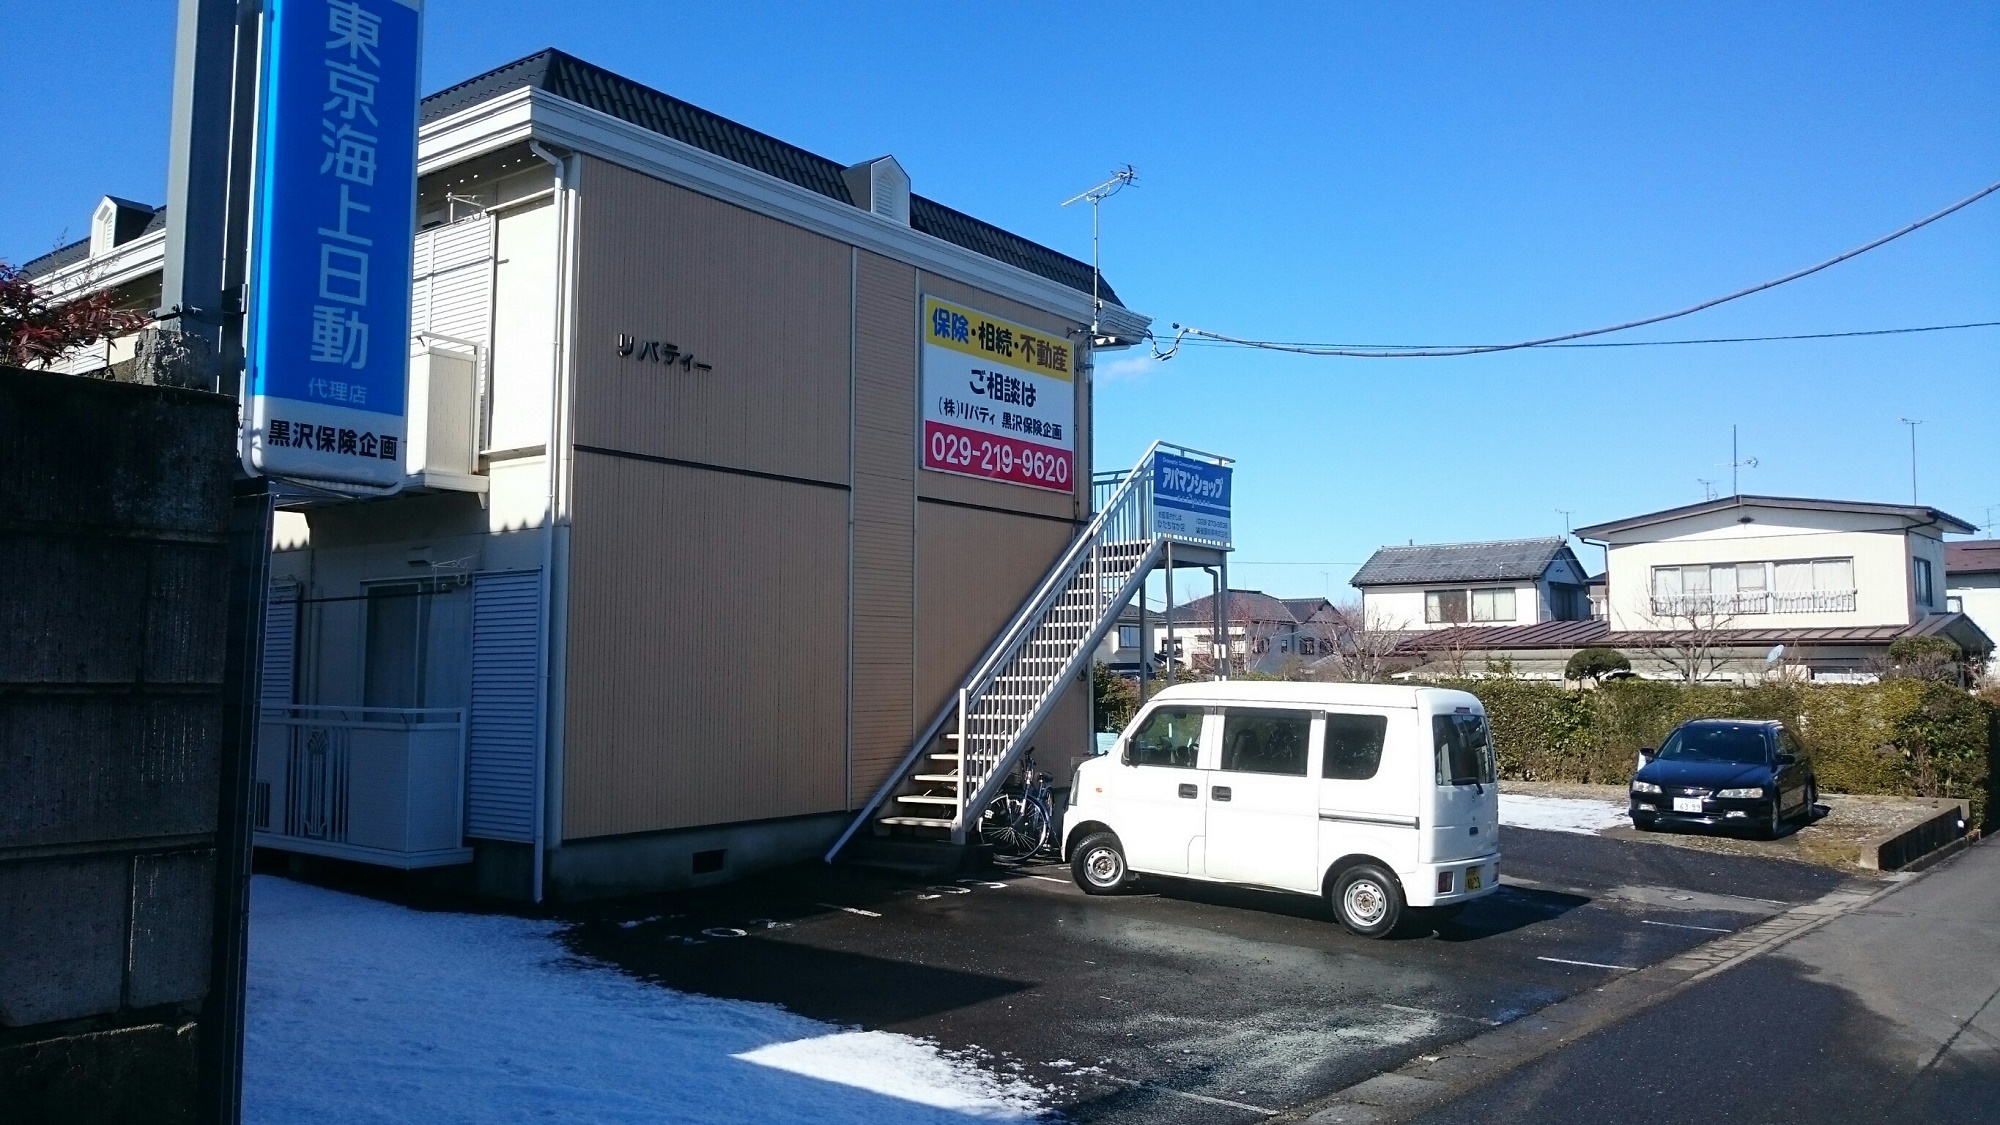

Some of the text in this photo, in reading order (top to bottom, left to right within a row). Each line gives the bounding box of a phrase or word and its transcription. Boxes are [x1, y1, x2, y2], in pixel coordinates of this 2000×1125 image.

[310, 0, 382, 370] 東京海上日動
[618, 333, 712, 372] リバティー
[932, 307, 1068, 373] 保険・相続・不動産
[308, 377, 367, 405] 代理店
[969, 369, 1037, 408] ご相談は
[267, 419, 398, 462] 黒沢保険企画
[1001, 411, 1062, 441] 黒沢保険企画
[932, 431, 1068, 484] 029-219-9620
[1163, 466, 1223, 498] アパマンショップ
[1157, 520, 1186, 532] ひたちなか店
